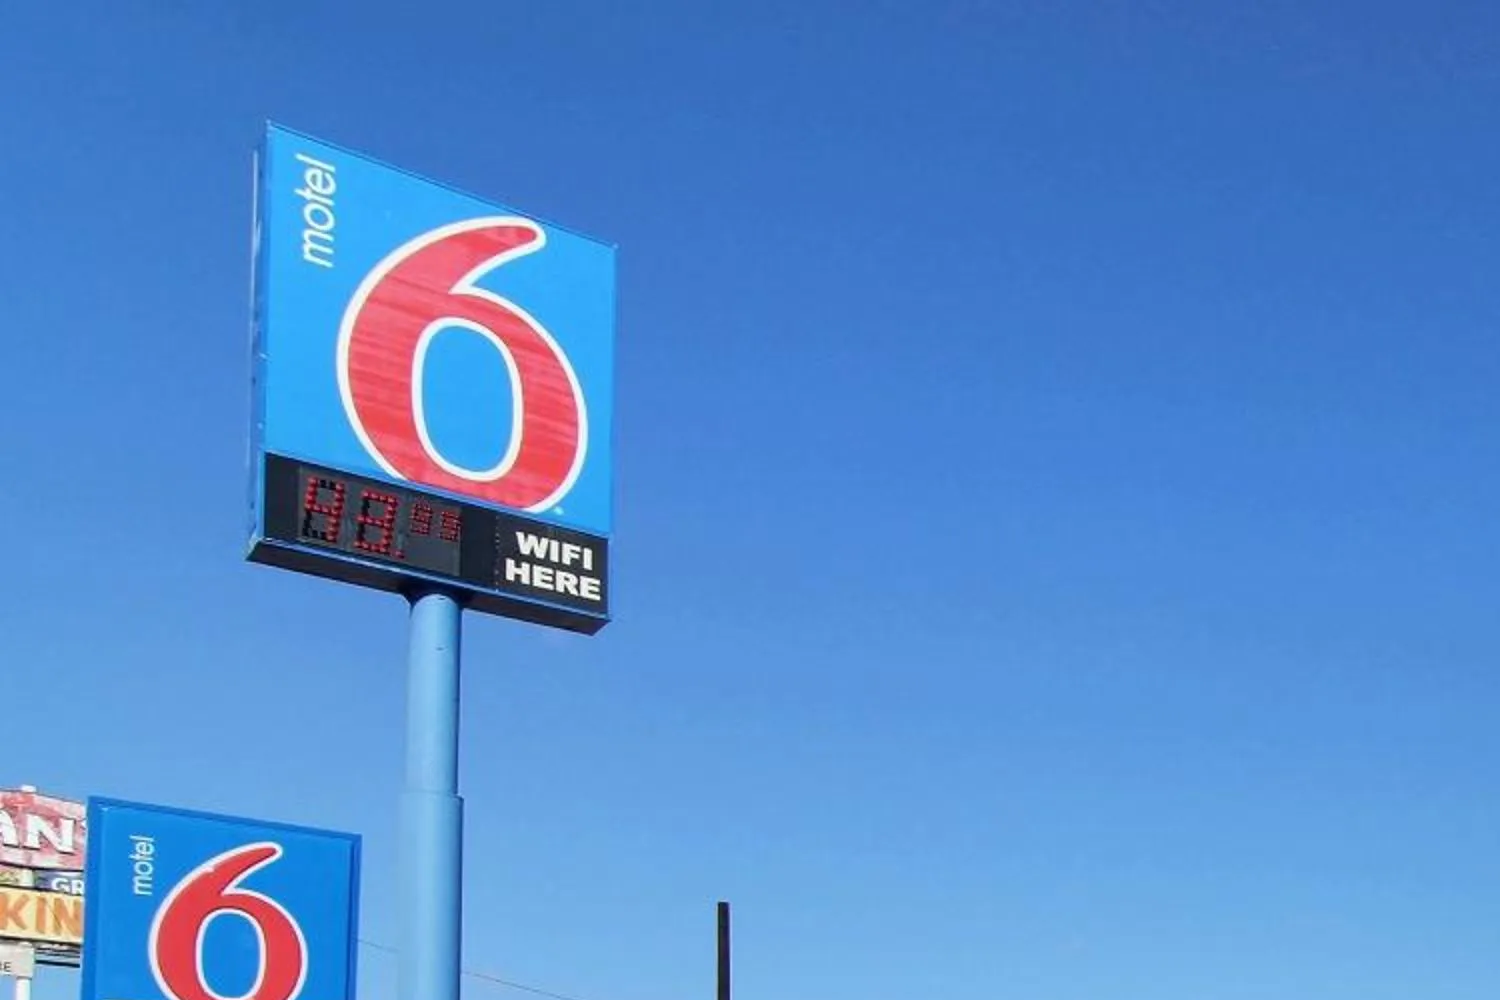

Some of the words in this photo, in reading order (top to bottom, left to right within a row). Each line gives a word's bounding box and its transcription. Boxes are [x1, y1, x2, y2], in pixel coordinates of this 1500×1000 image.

[295, 153, 336, 268] motel
[336, 215, 588, 514] 6
[504, 557, 601, 600] HERE
[515, 531, 593, 570] WIFI
[129, 835, 155, 895] motel
